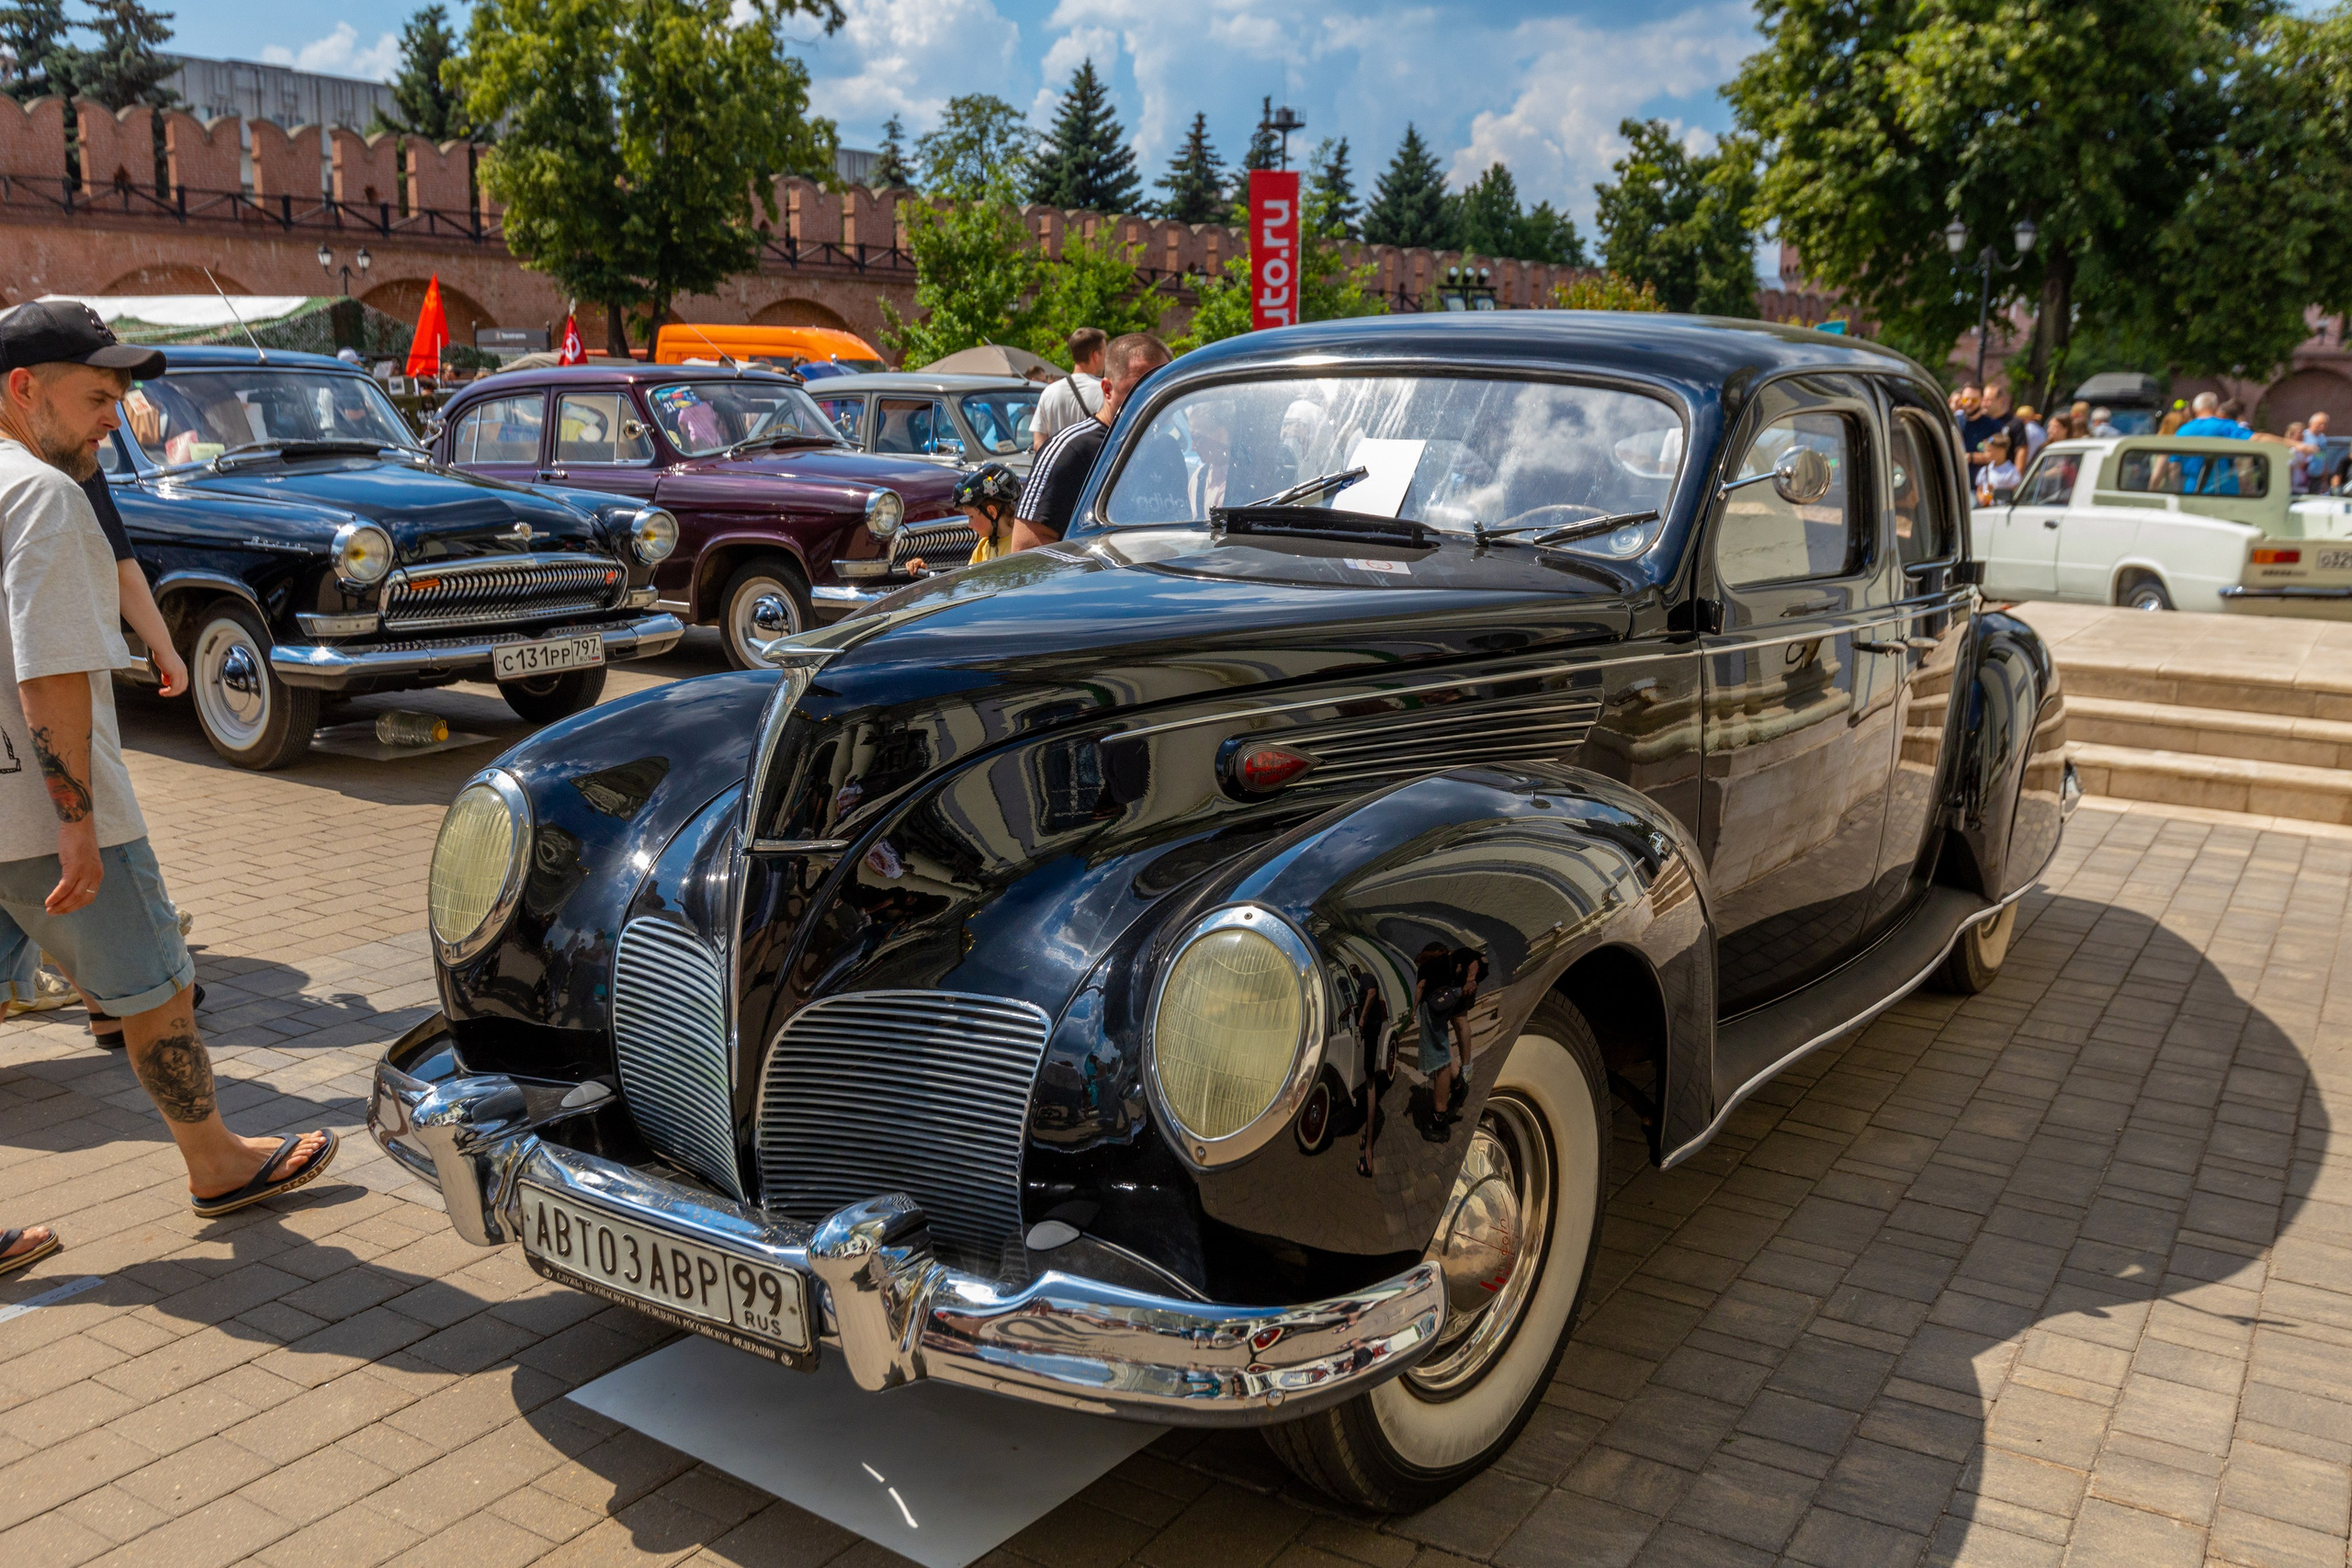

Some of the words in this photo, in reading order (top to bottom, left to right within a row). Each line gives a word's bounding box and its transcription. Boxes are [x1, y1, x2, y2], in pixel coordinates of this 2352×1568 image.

[572, 638, 597, 657] 797
[280, 1166, 323, 1192] crocs
[732, 1263, 782, 1317] 99
[557, 1272, 583, 1289] СЛУЖБА
[584, 1282, 637, 1309] БЕЗОПАСНОСТИ
[638, 1303, 681, 1325] ПРЕЗИДЕНТА
[683, 1318, 730, 1344] РОССИЙСКОЙ
[731, 1337, 776, 1359] ФЕДЕРАЦИИ
[744, 1310, 782, 1337] RUS
